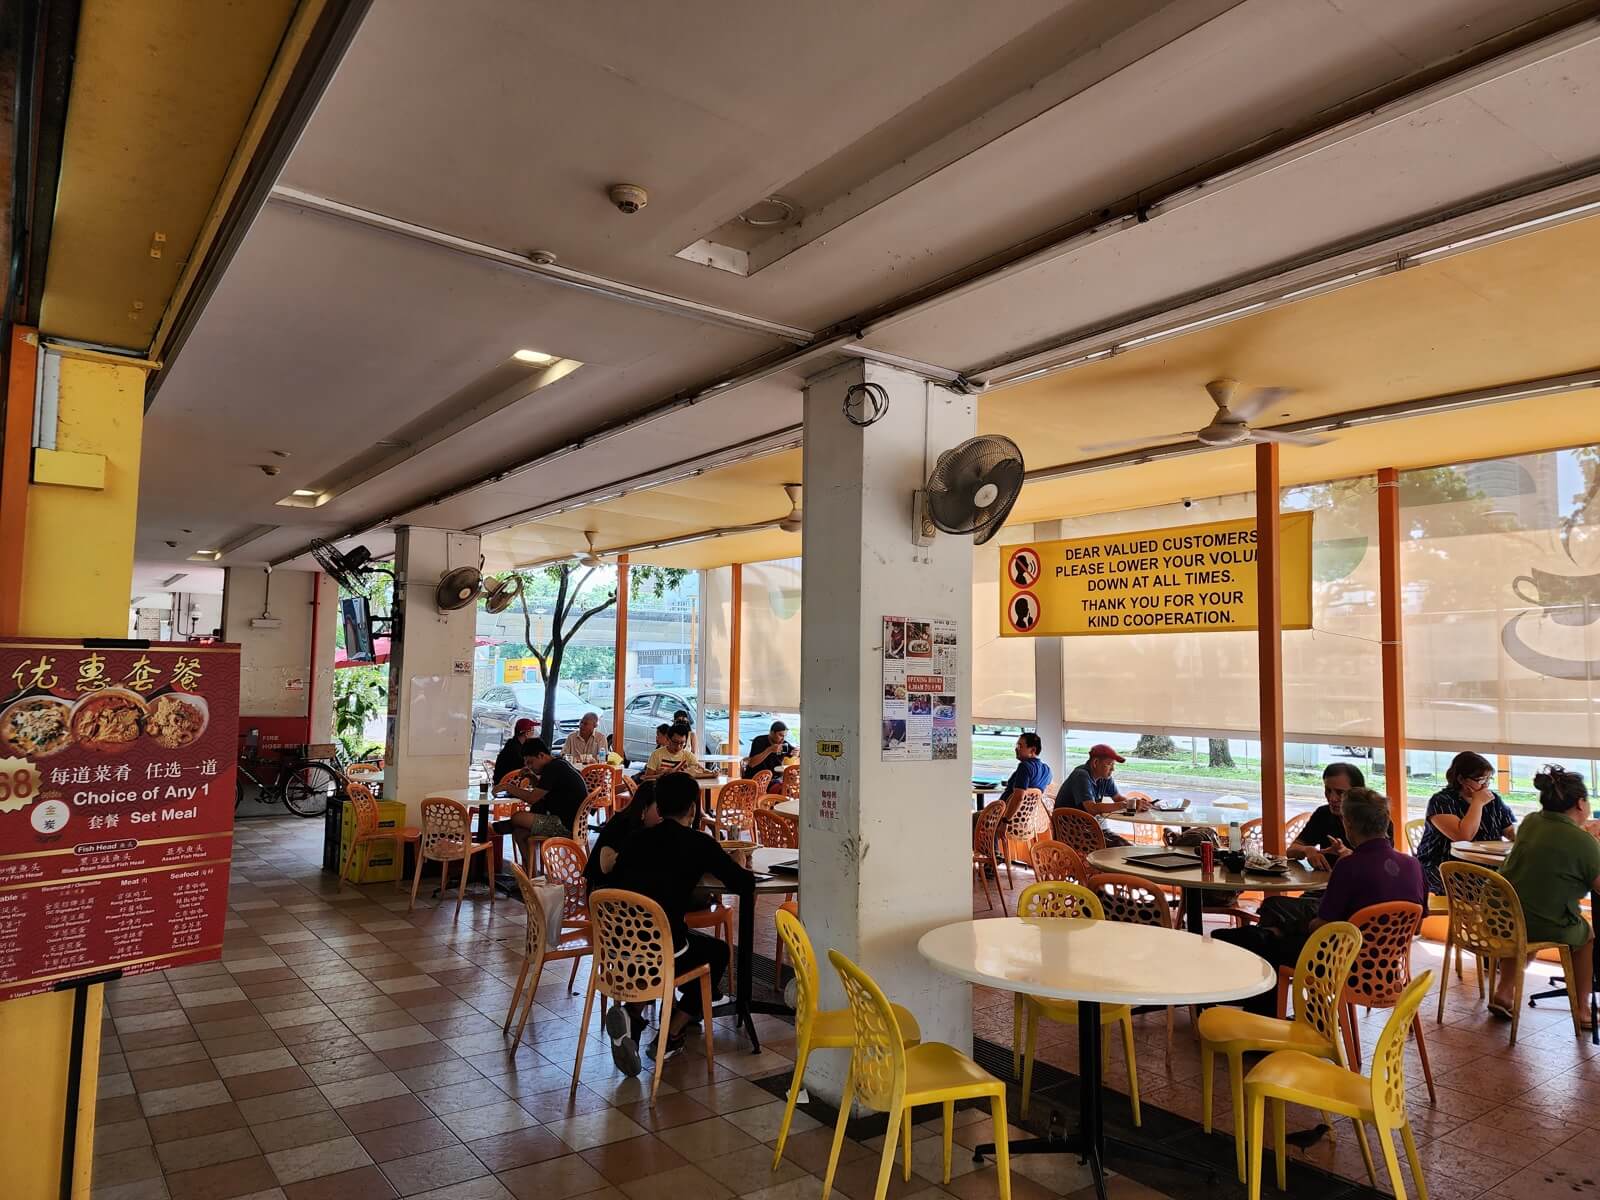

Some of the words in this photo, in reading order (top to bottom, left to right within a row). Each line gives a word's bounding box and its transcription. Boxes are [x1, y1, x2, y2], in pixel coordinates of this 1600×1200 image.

[1065, 546, 1100, 561] DEAR
[1104, 540, 1158, 557] VALUED
[1162, 530, 1258, 551] CUSTOMERS
[1055, 562, 1105, 578] PLEASE
[1109, 557, 1159, 574] LOWER
[1163, 552, 1205, 568] YOUR
[1208, 548, 1258, 565] VOLU
[1088, 578, 1128, 592] DOWN
[1132, 576, 1149, 589] AT
[1152, 573, 1181, 588] ALL
[1185, 569, 1235, 585] TIMES.
[1081, 598, 1127, 611] THANK
[1130, 595, 1160, 609] YOU
[1164, 593, 1194, 607] FOR
[1199, 590, 1244, 605] YOUR
[1088, 614, 1119, 628] KIND
[1123, 610, 1235, 626] COOPERATION.
[11, 652, 203, 692] 优惠套餐
[50, 763, 132, 785] 每道菜肴
[145, 759, 218, 779] 任选一道
[73, 789, 137, 806] Choice
[142, 786, 160, 800] of
[164, 785, 197, 801] Any
[202, 783, 210, 796] 1
[88, 814, 120, 831] 套餐
[130, 810, 157, 825] Set
[161, 807, 197, 821] Meal
[77, 845, 95, 853] Fish
[96, 843, 117, 851] Head
[120, 878, 140, 886] Meat
[170, 870, 200, 880] Seafood
